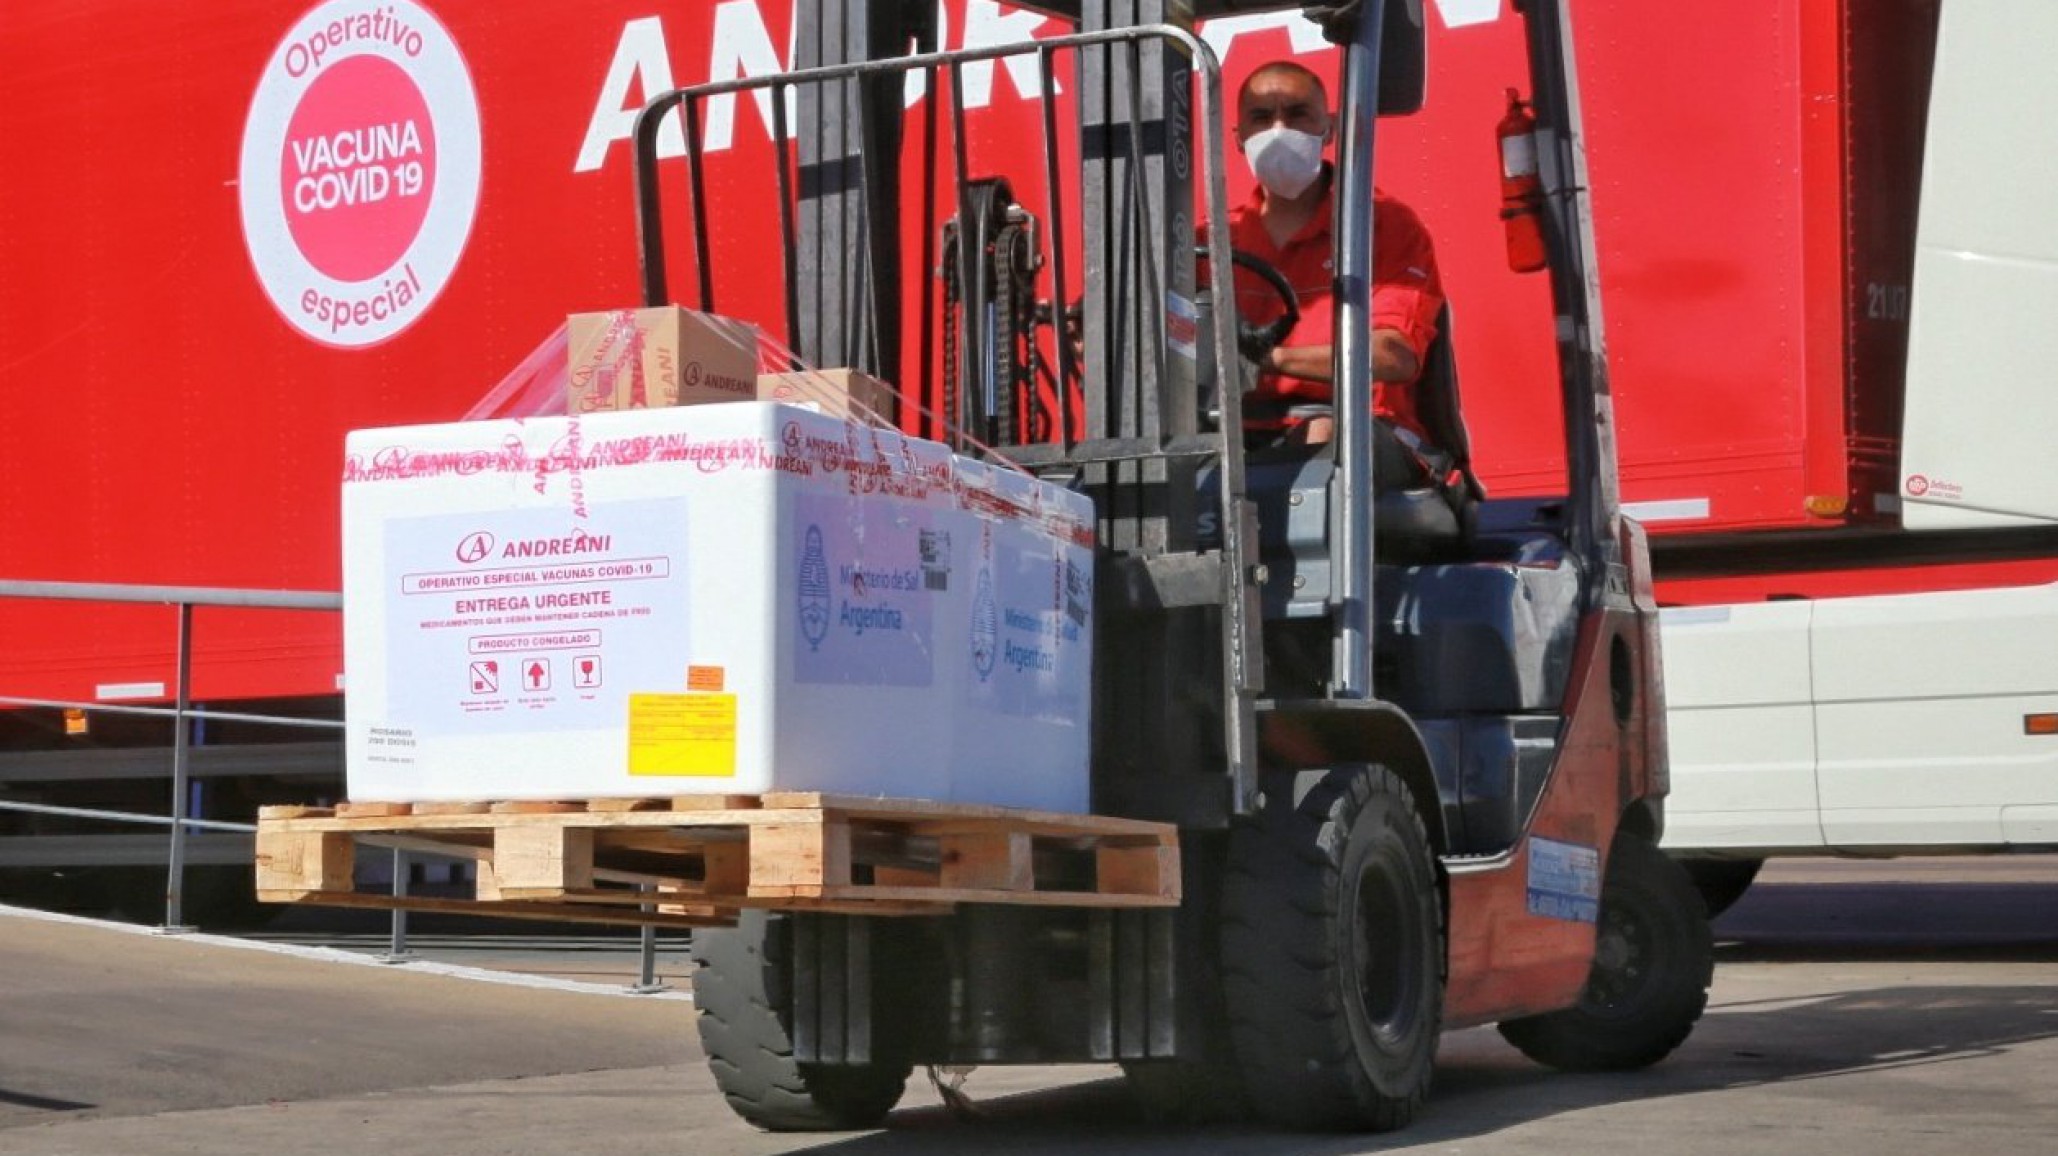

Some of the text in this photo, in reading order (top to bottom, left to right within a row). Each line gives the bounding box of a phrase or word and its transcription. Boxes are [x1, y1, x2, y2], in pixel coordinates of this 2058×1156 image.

[284, 5, 424, 80] Operativo
[292, 121, 422, 171] VACUNA
[293, 160, 423, 213] COVID 19
[301, 262, 422, 334] especial
[502, 534, 611, 559] ANDREANI
[418, 563, 653, 589] OPERATIVO ESPECIAL VACUNAS COVID-19
[841, 565, 890, 589] Misterio
[455, 590, 611, 614] ENTREGA URGENTE
[840, 600, 902, 636] Argentina
[477, 634, 592, 649] PRODUCTO CONGELADO
